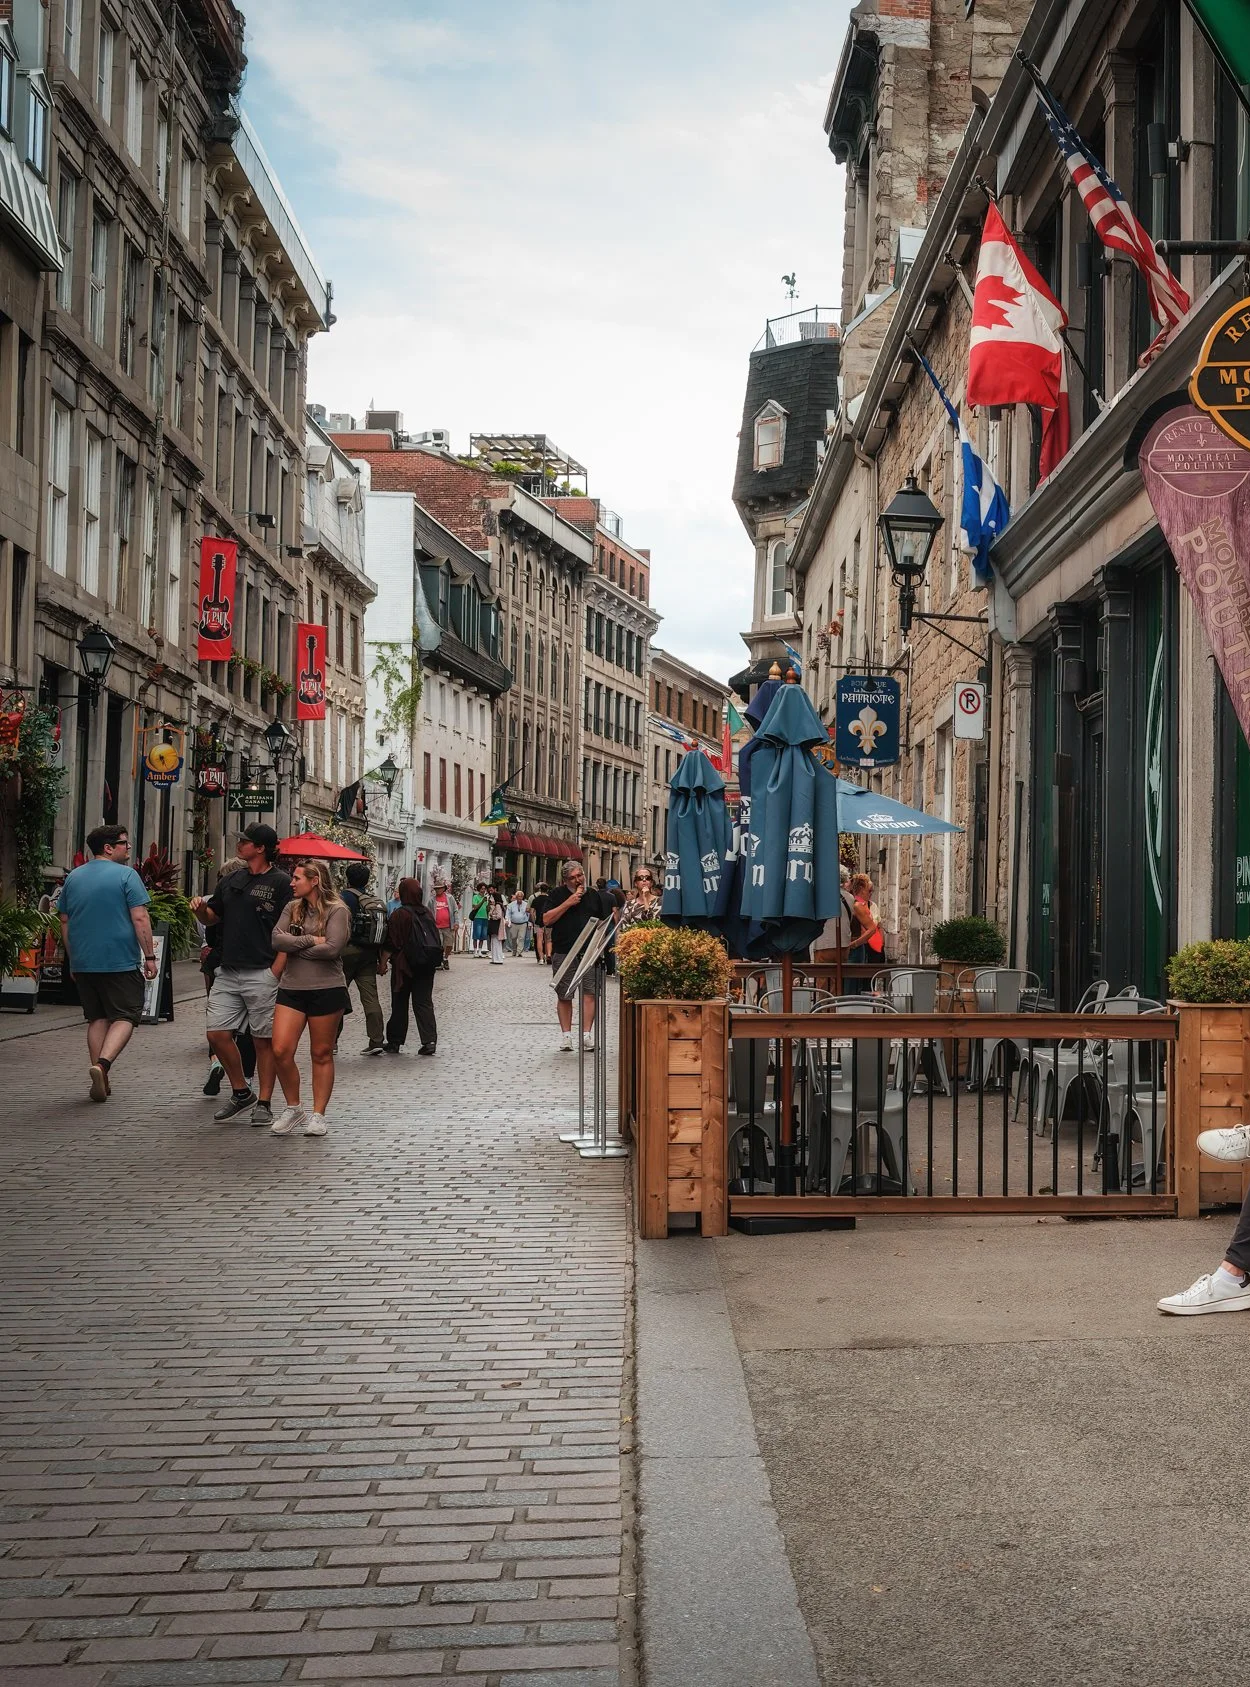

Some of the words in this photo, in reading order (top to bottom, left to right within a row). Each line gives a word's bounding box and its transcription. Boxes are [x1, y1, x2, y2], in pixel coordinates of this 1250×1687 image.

[1164, 421, 1202, 444] RESTO
[1167, 453, 1240, 463] MONTREAL
[1174, 461, 1234, 471] POUTINE
[841, 693, 895, 705] PATRIOTE
[145, 771, 177, 782] Amber
[198, 770, 208, 789] ST.
[209, 771, 226, 790] PAUL
[856, 819, 921, 831] Corona
